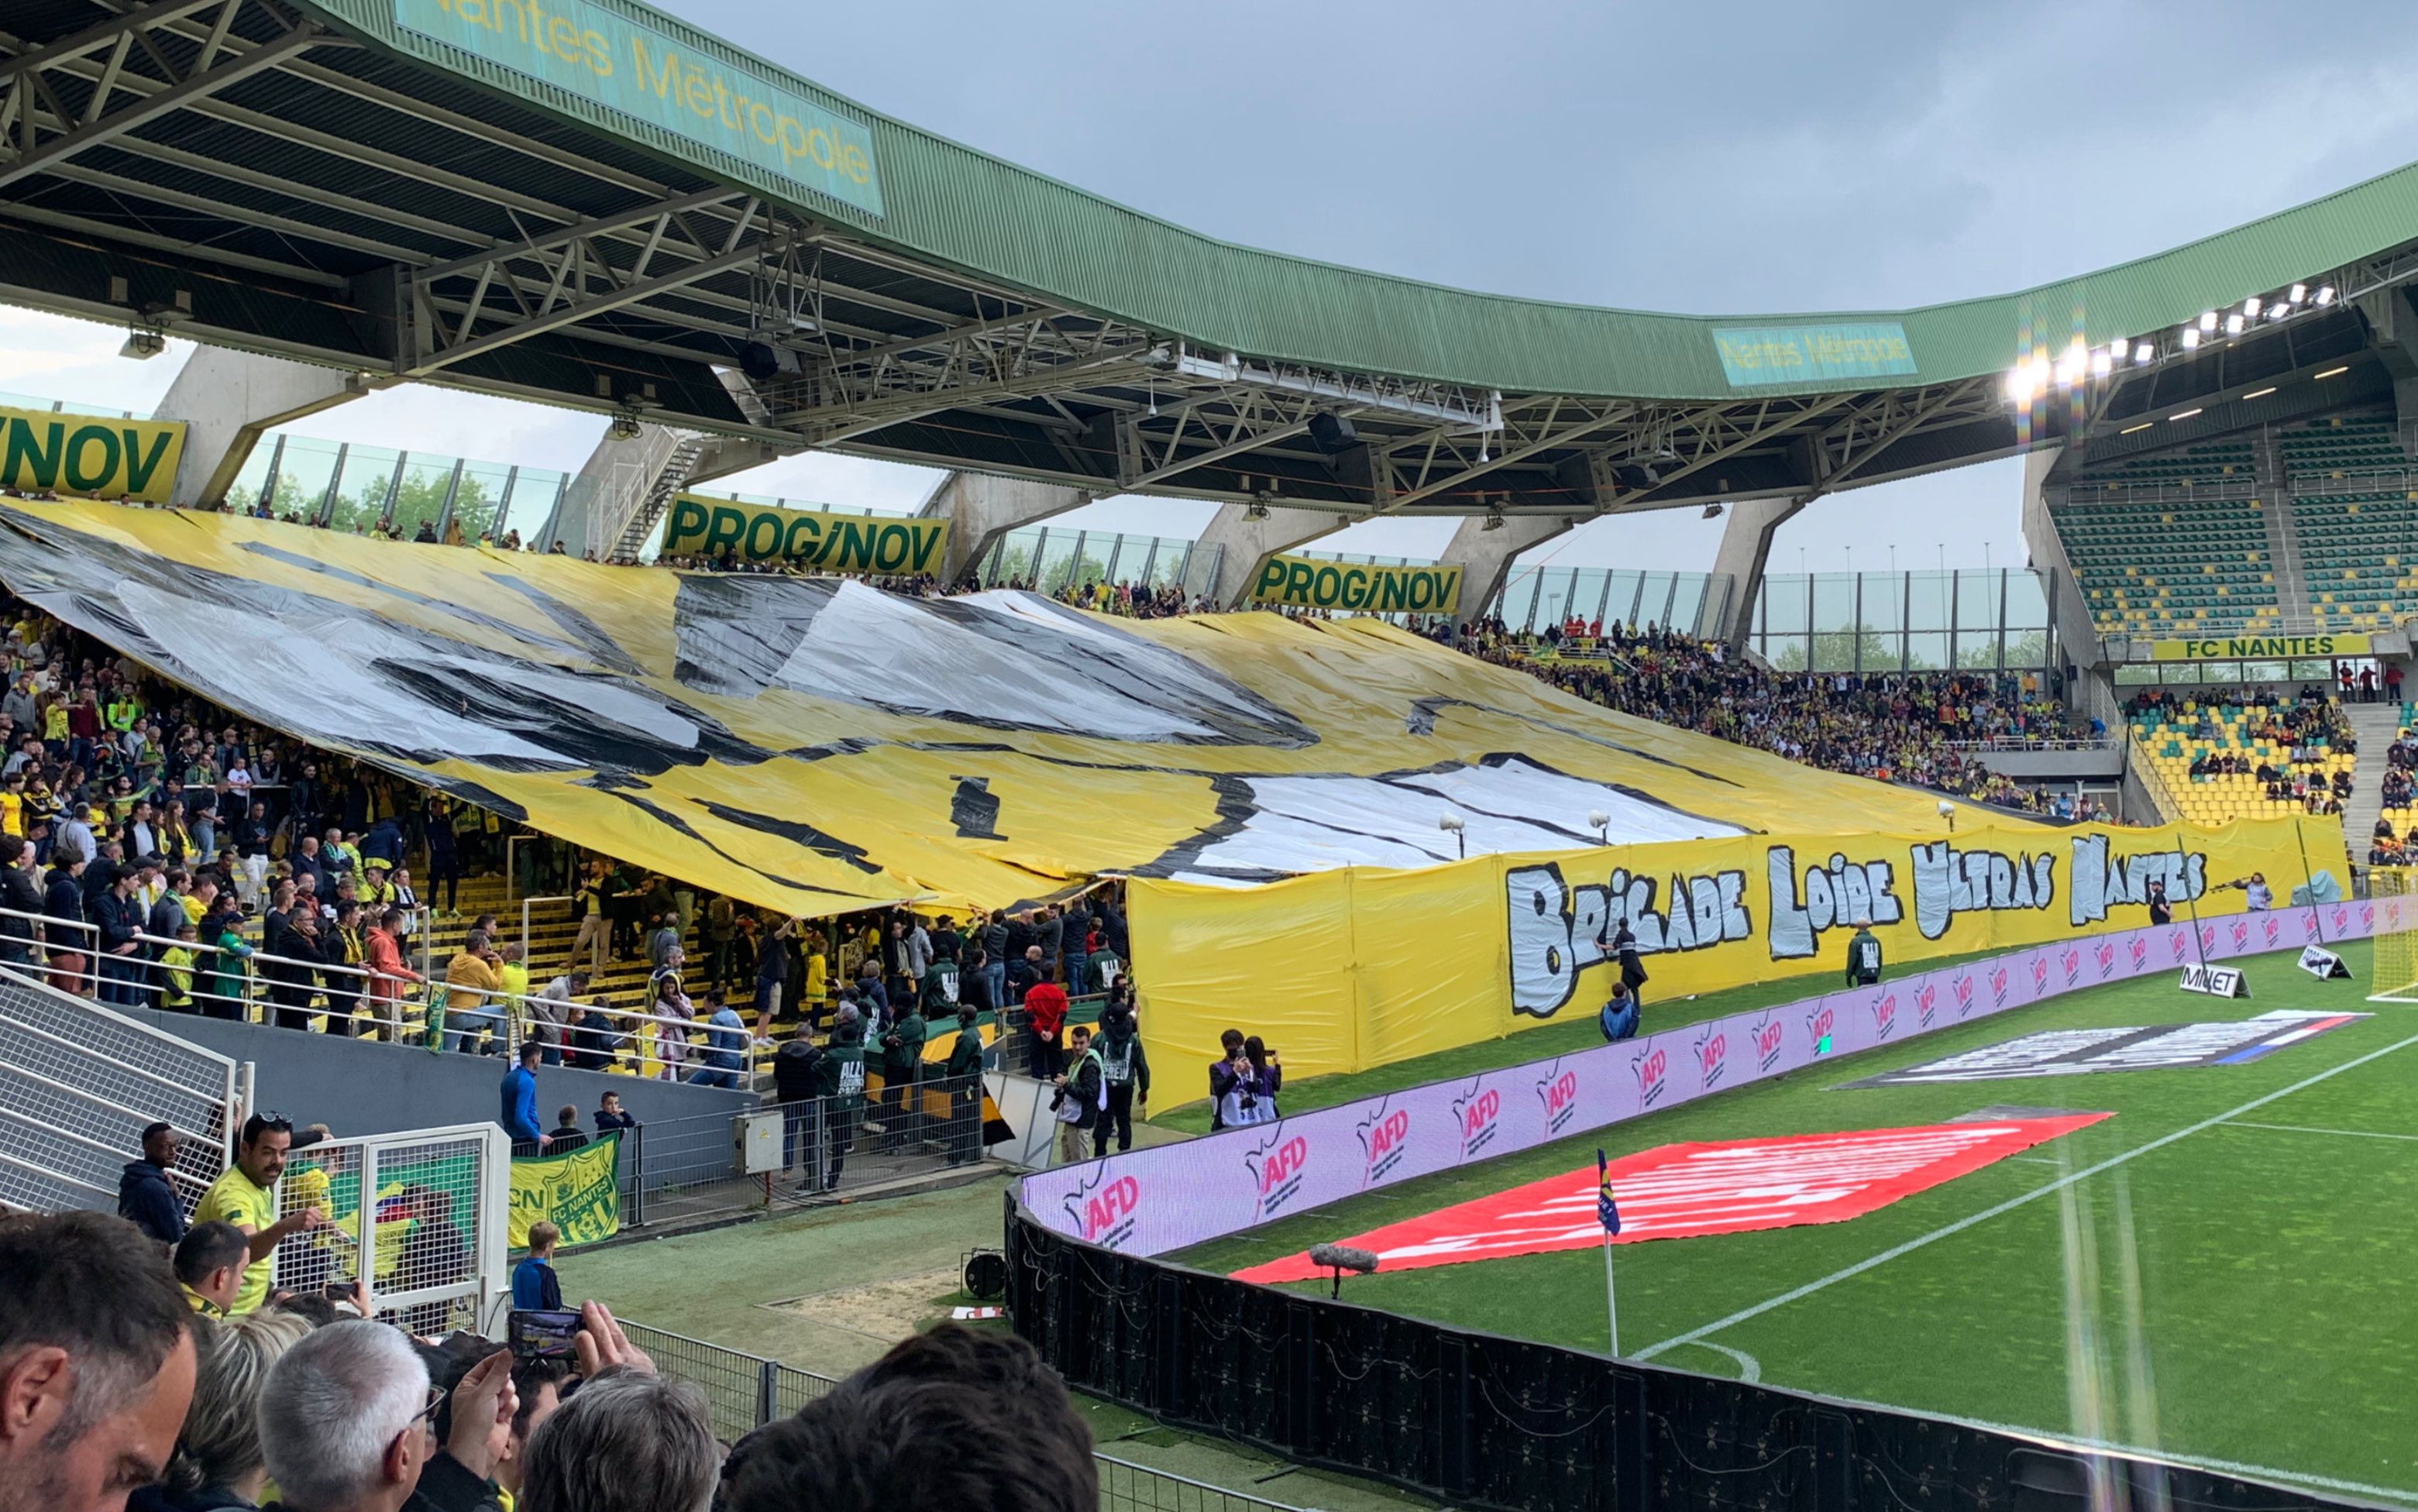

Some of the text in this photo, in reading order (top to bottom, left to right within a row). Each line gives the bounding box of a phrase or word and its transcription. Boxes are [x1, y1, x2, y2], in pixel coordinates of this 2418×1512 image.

[435, 0, 614, 77] antes
[2186, 636, 2334, 658] FC NANTES
[1919, 985, 1935, 1015] AFD
[1958, 976, 1973, 1005] AFD
[1993, 967, 2007, 996] AFD
[1813, 1009, 1833, 1043] AFD
[1878, 995, 1896, 1027] AFD
[1704, 1033, 1725, 1074] AFD
[1760, 1021, 1781, 1058] AFD
[1642, 1049, 1666, 1091] AFD
[1466, 1089, 1499, 1139] AFD
[1550, 1070, 1576, 1117] AFD
[1371, 1109, 1408, 1163] AFD
[1265, 1136, 1307, 1194] AFD
[552, 1207, 566, 1223] FC
[568, 1180, 608, 1214] NANTES
[1089, 1175, 1140, 1240] AFD
